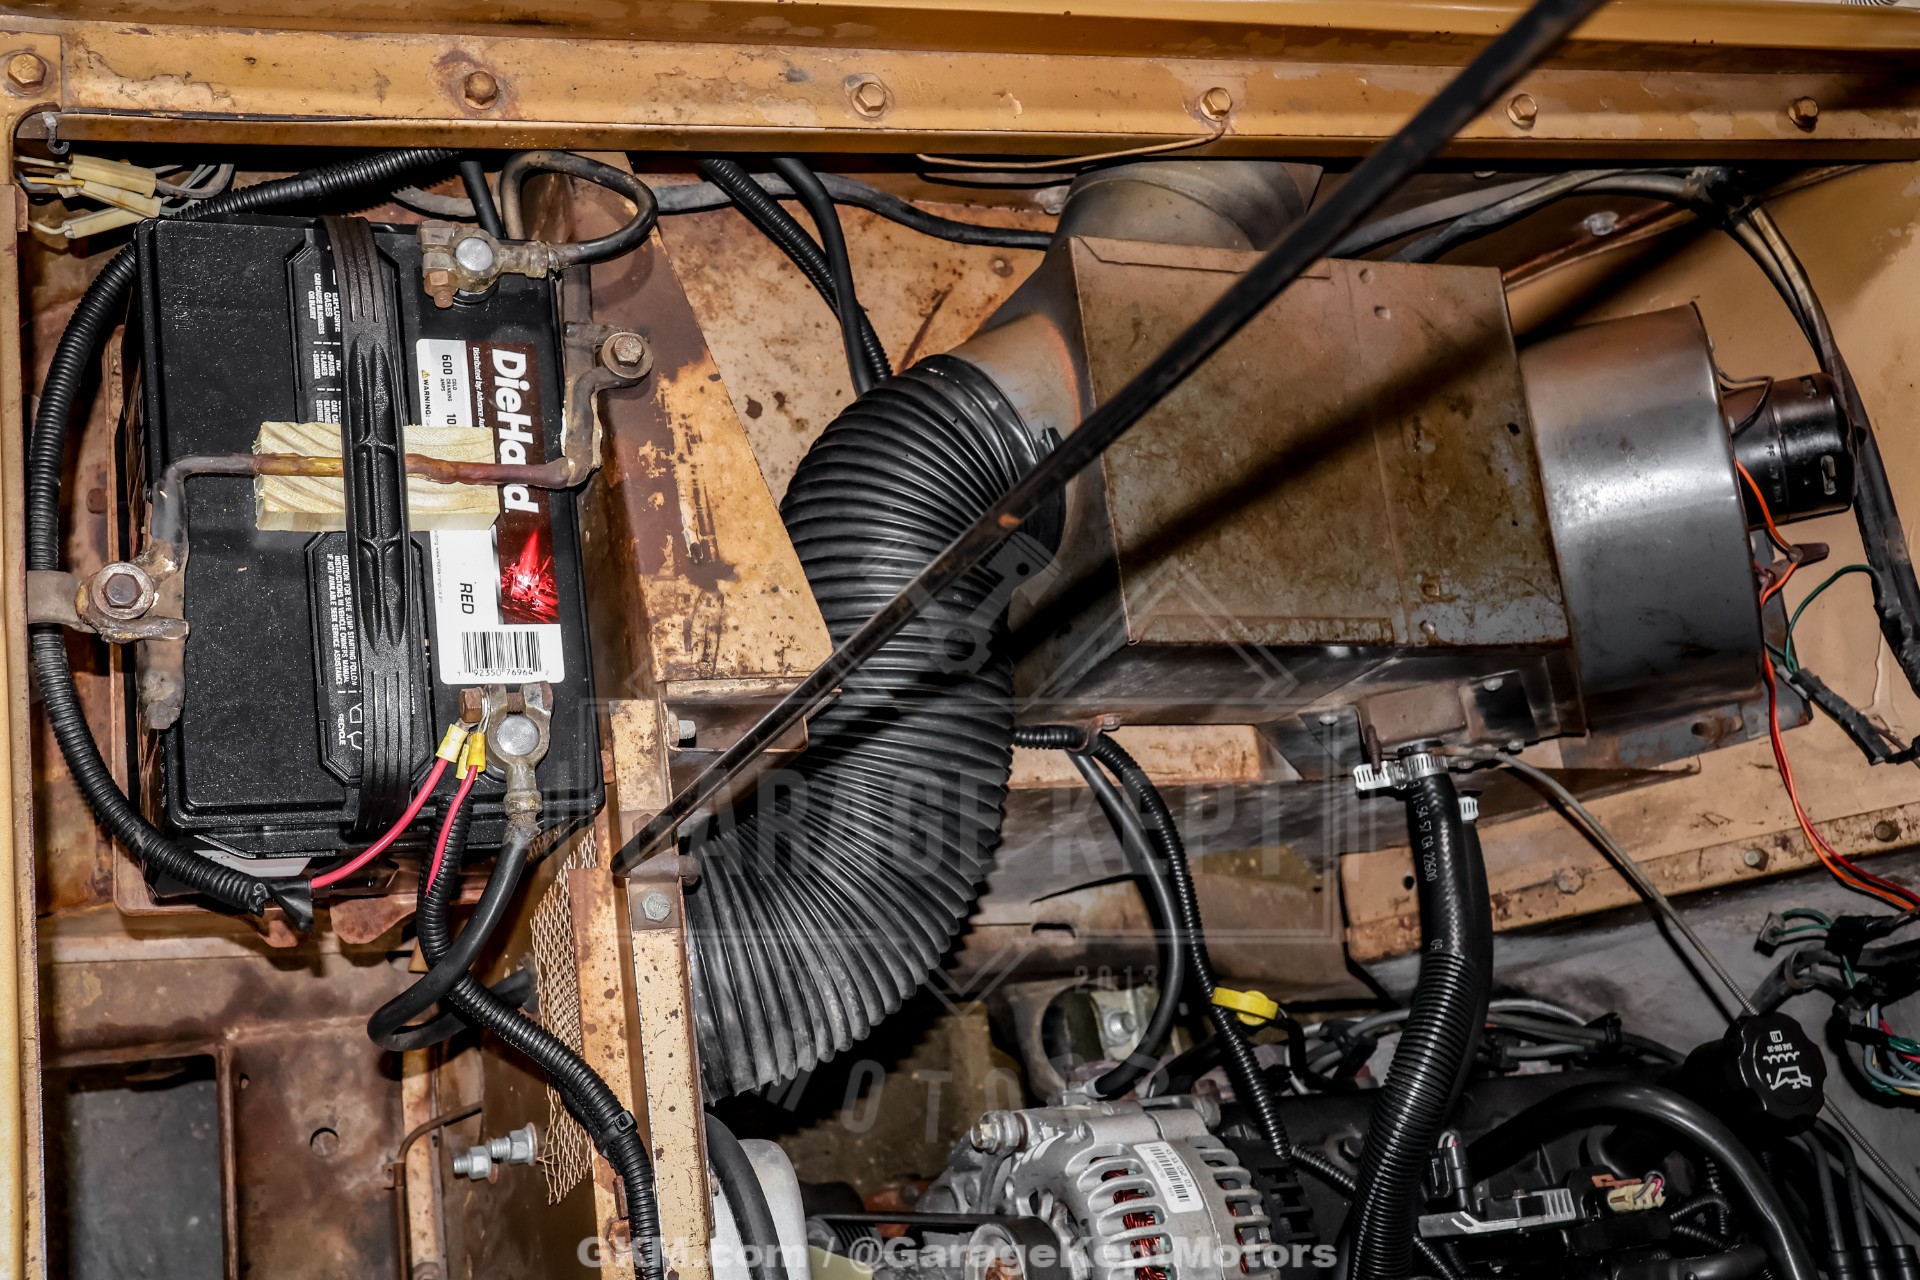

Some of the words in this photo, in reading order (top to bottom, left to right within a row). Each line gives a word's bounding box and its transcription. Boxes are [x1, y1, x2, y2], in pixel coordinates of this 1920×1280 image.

[324, 292, 333, 317] GASES
[442, 354, 453, 375] 600
[473, 347, 482, 380] Distributed
[477, 391, 485, 417] Advance
[491, 348, 539, 514] DieHad
[328, 561, 336, 573] NOT
[329, 575, 338, 605] AVAILABLE
[460, 583, 475, 614] RED
[330, 607, 338, 622] SEEK
[345, 597, 353, 612] SAFE
[338, 606, 347, 631] VEHICLE
[346, 614, 354, 629] JUMP
[332, 623, 340, 648] SERVICE
[348, 631, 356, 659] STARTING
[334, 649, 343, 686] ASSISTANCE
[473, 668, 502, 677] 92350
[506, 668, 534, 676] 76964
[338, 713, 346, 746] RECYCLE
